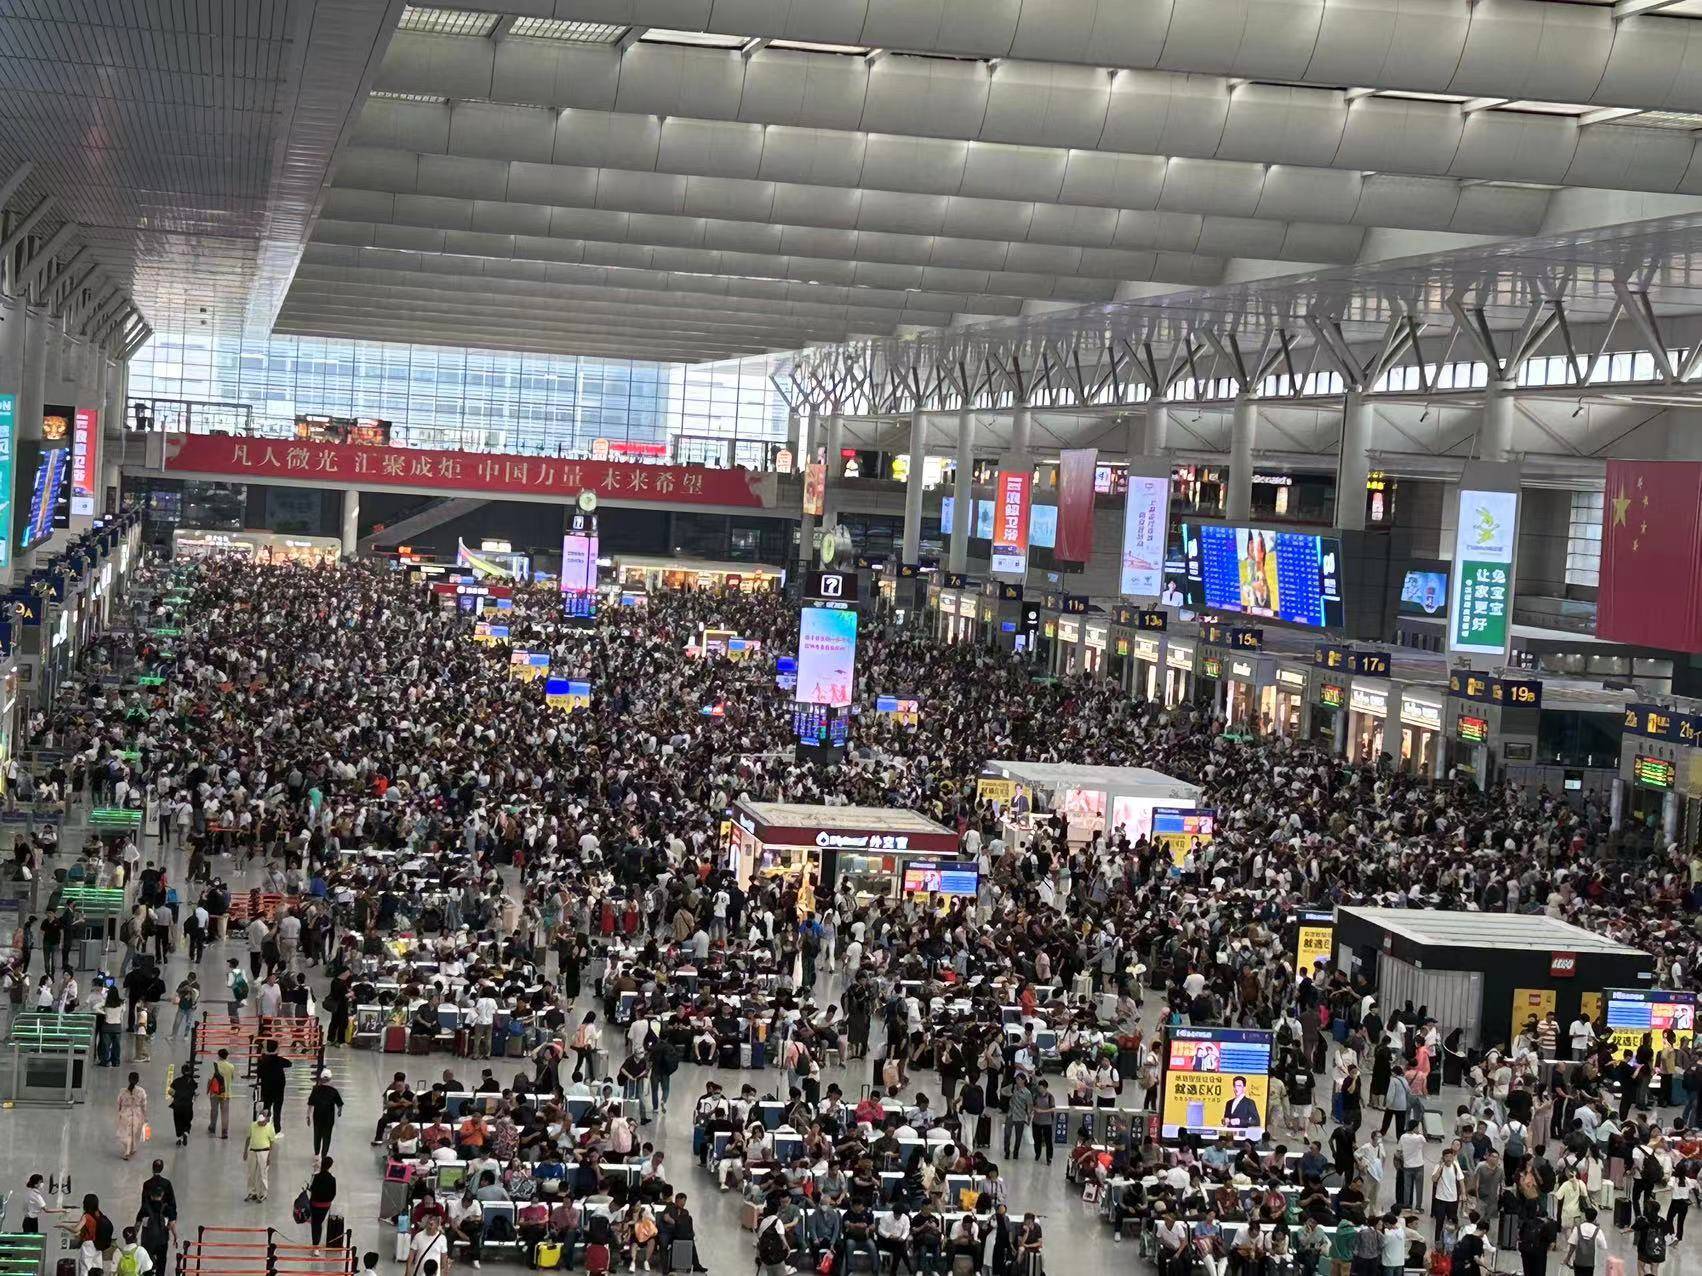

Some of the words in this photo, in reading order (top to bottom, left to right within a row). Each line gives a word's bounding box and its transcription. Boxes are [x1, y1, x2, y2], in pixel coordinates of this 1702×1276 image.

[231, 443, 339, 473] 凡人微光
[354, 451, 463, 479] 汇聚成炬
[478, 460, 583, 487] 中国力量
[600, 467, 703, 495] 未来希望
[1471, 568, 1491, 632] 让家更好
[1551, 957, 1574, 970] LEGO
